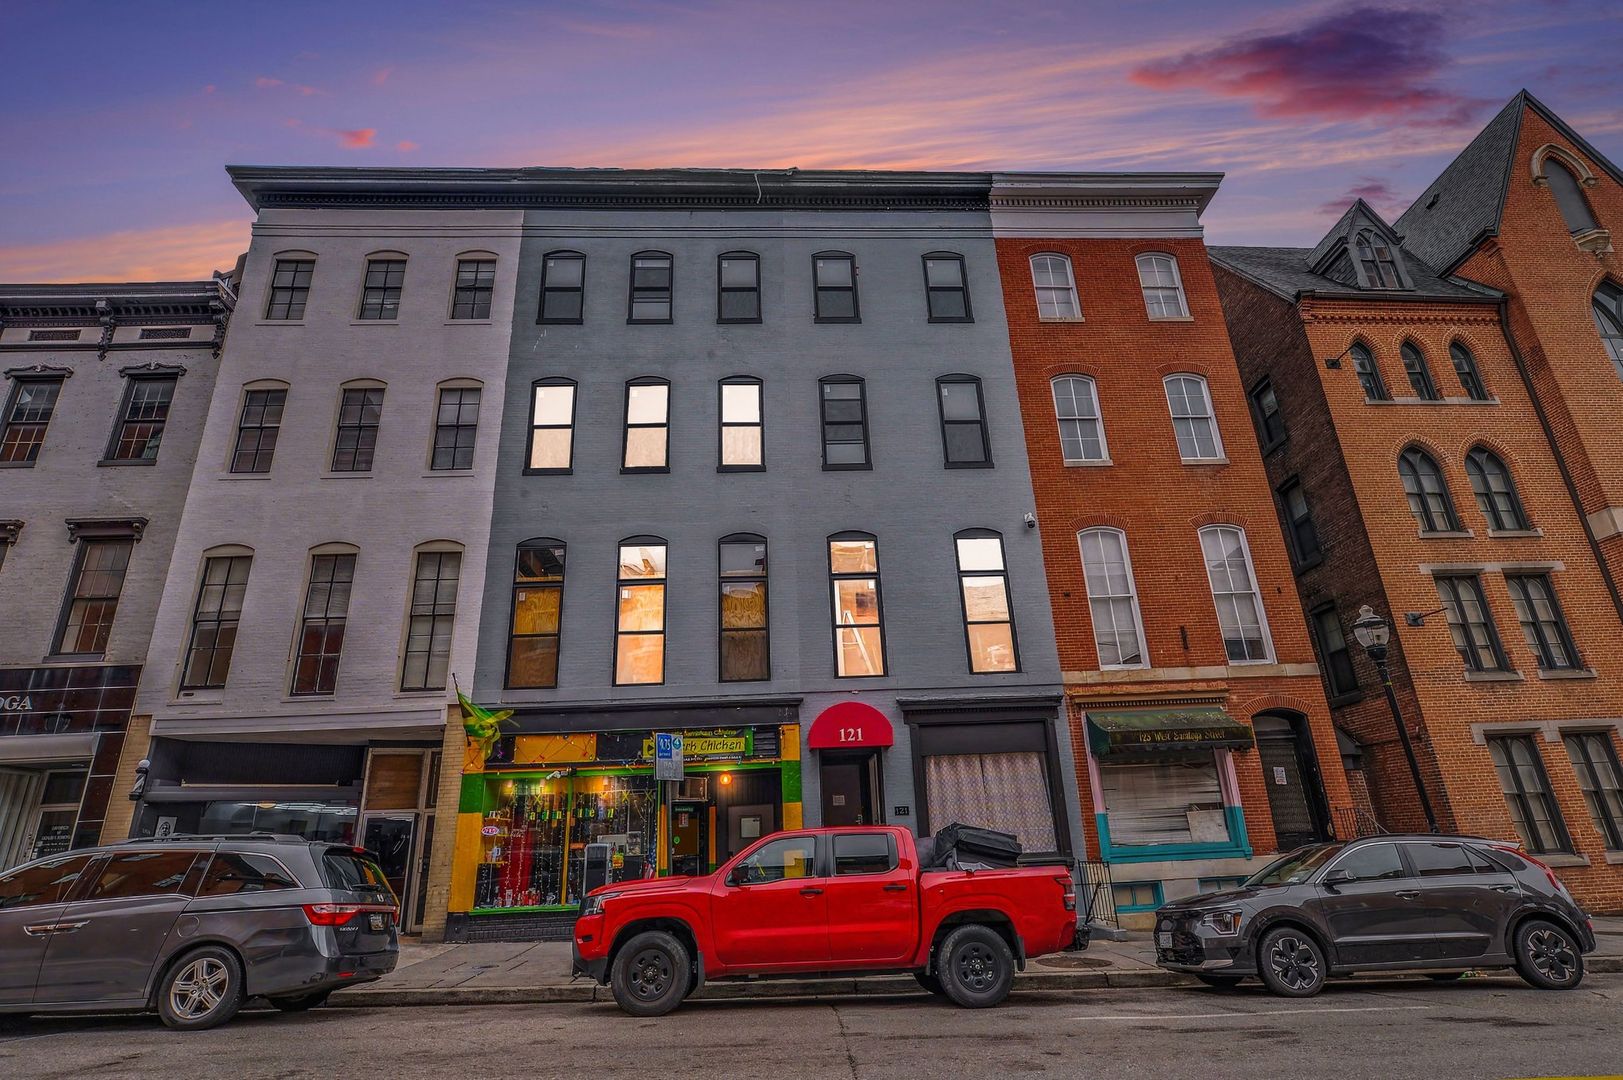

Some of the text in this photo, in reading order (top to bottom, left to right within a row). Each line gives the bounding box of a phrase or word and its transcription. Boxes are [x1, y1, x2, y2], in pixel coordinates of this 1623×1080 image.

[839, 727, 863, 742] 121
[1139, 731, 1152, 742] 123
[1154, 731, 1172, 741] West
[700, 739, 742, 751] Chicken
[895, 807, 908, 815] 121
